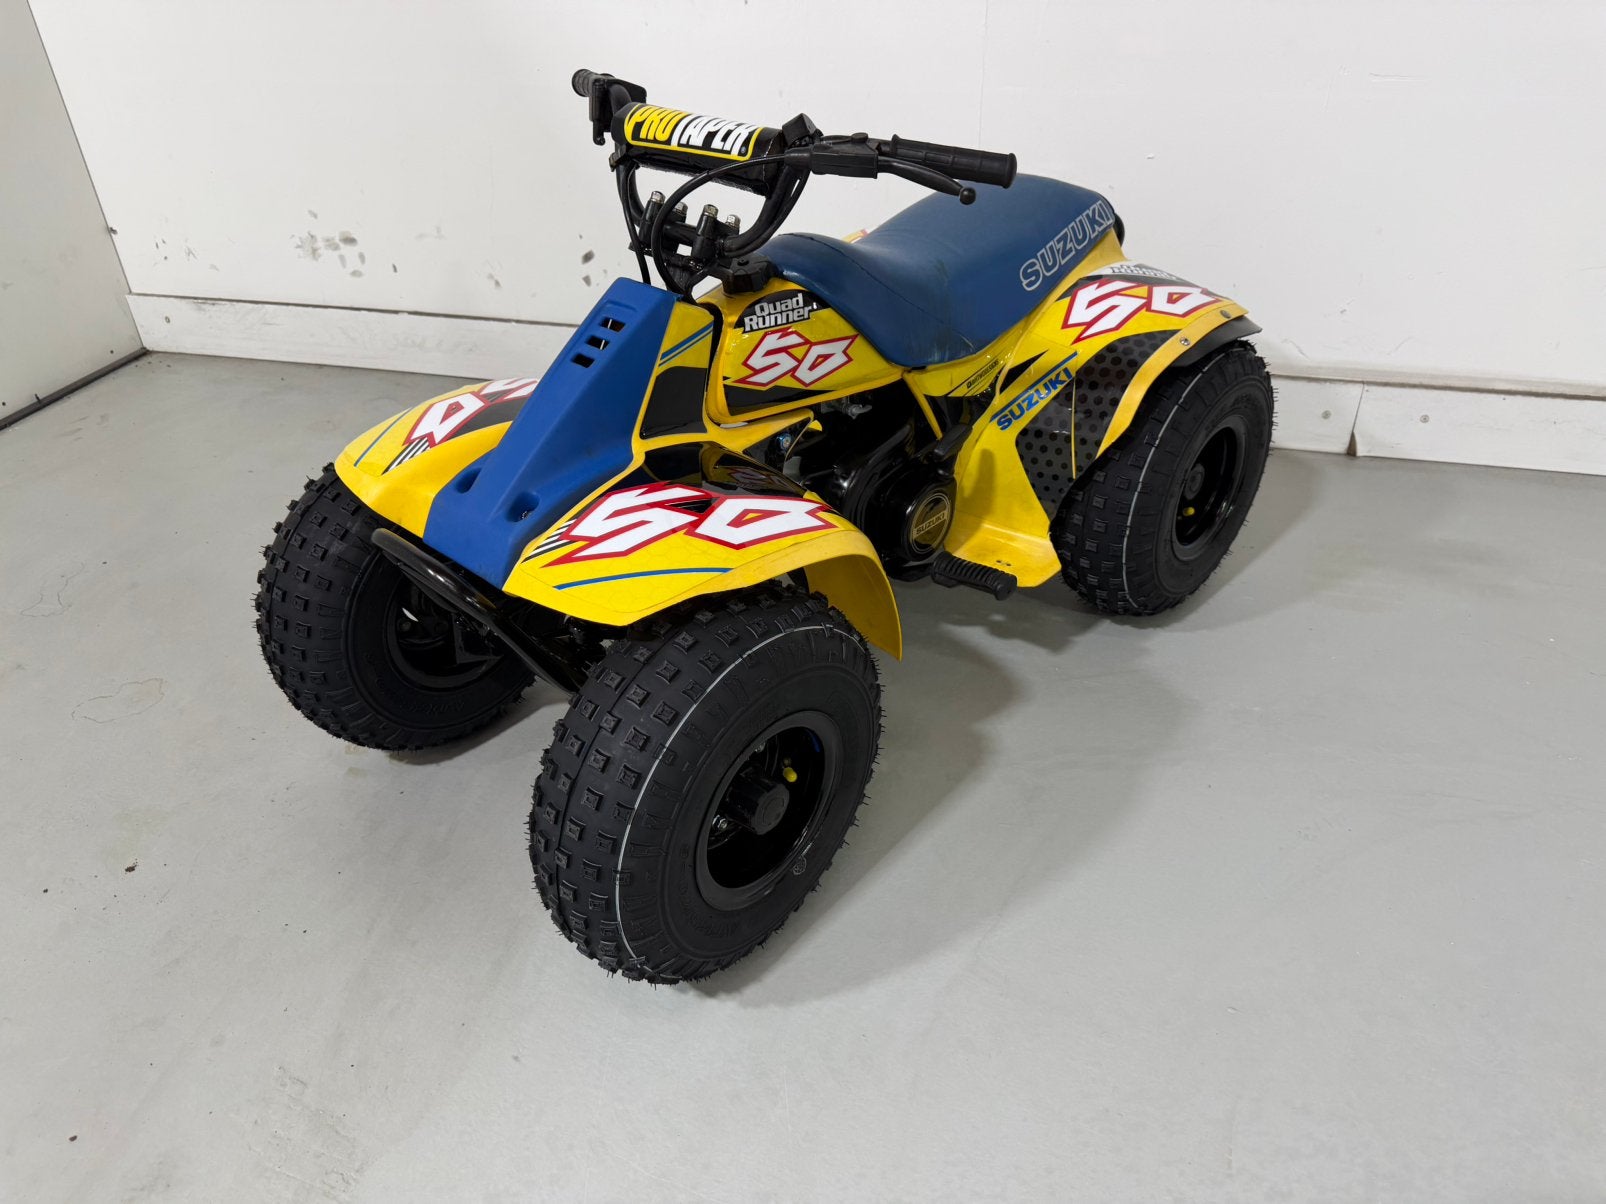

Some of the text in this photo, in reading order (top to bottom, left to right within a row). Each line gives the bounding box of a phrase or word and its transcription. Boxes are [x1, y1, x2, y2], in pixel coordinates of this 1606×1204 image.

[1020, 200, 1114, 291] SUZUKI
[743, 305, 812, 332] Runner
[755, 292, 804, 317] Quad
[1062, 278, 1222, 345] 50
[732, 326, 860, 388] 50
[996, 367, 1073, 431] SUZUKI
[541, 481, 838, 568] 50
[915, 512, 946, 536] SUZUKI
